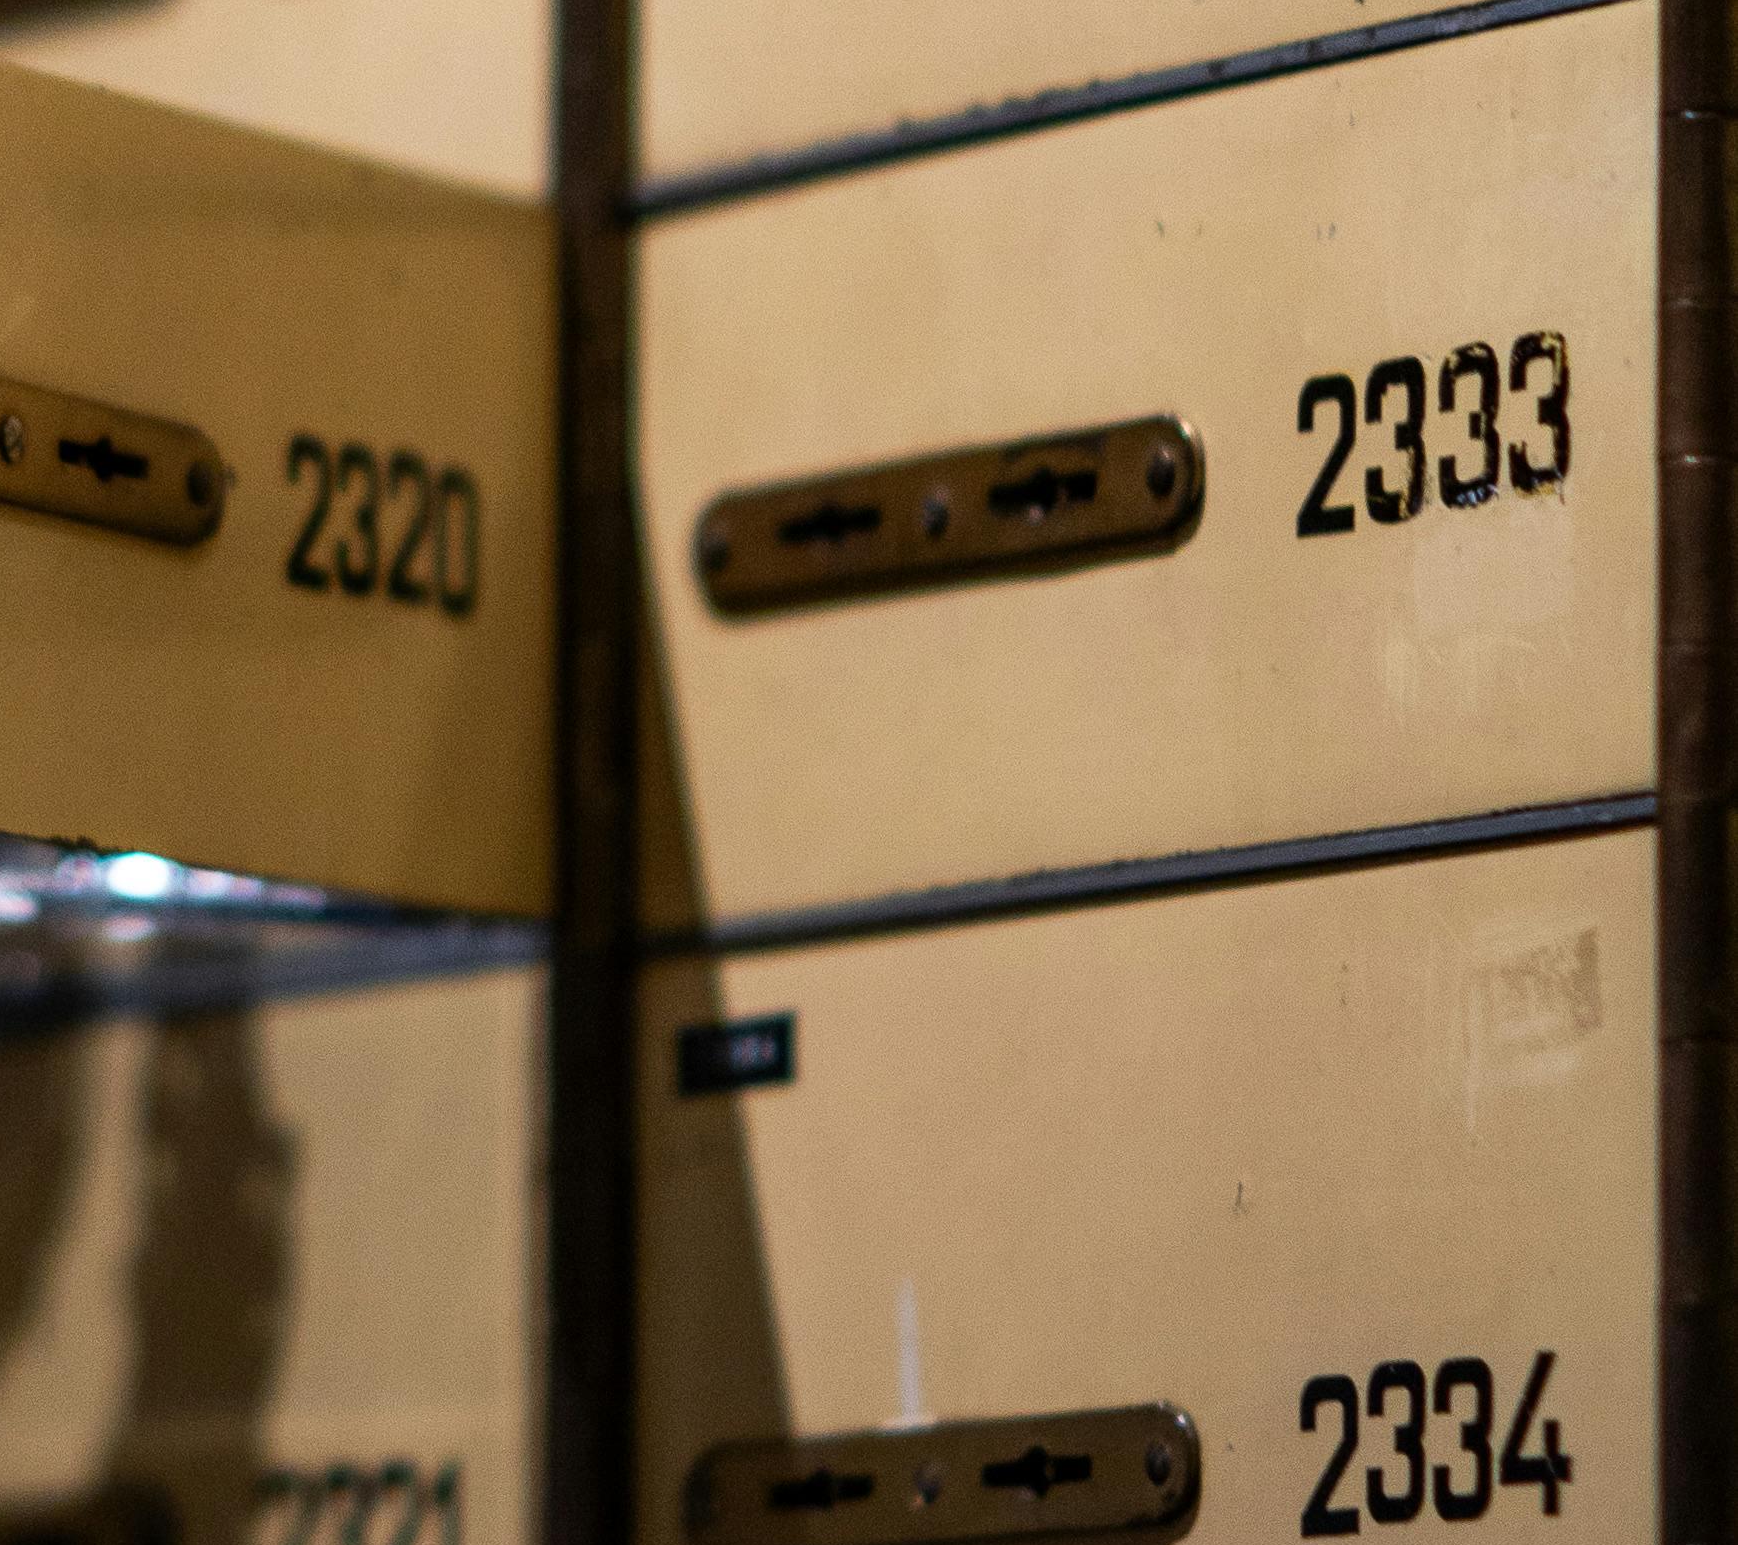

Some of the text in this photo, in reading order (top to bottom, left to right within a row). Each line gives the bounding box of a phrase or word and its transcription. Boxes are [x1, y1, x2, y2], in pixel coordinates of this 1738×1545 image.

[285, 431, 481, 621] 2320
[1297, 334, 1572, 538] 2333
[1299, 1351, 1573, 1538] 2334
